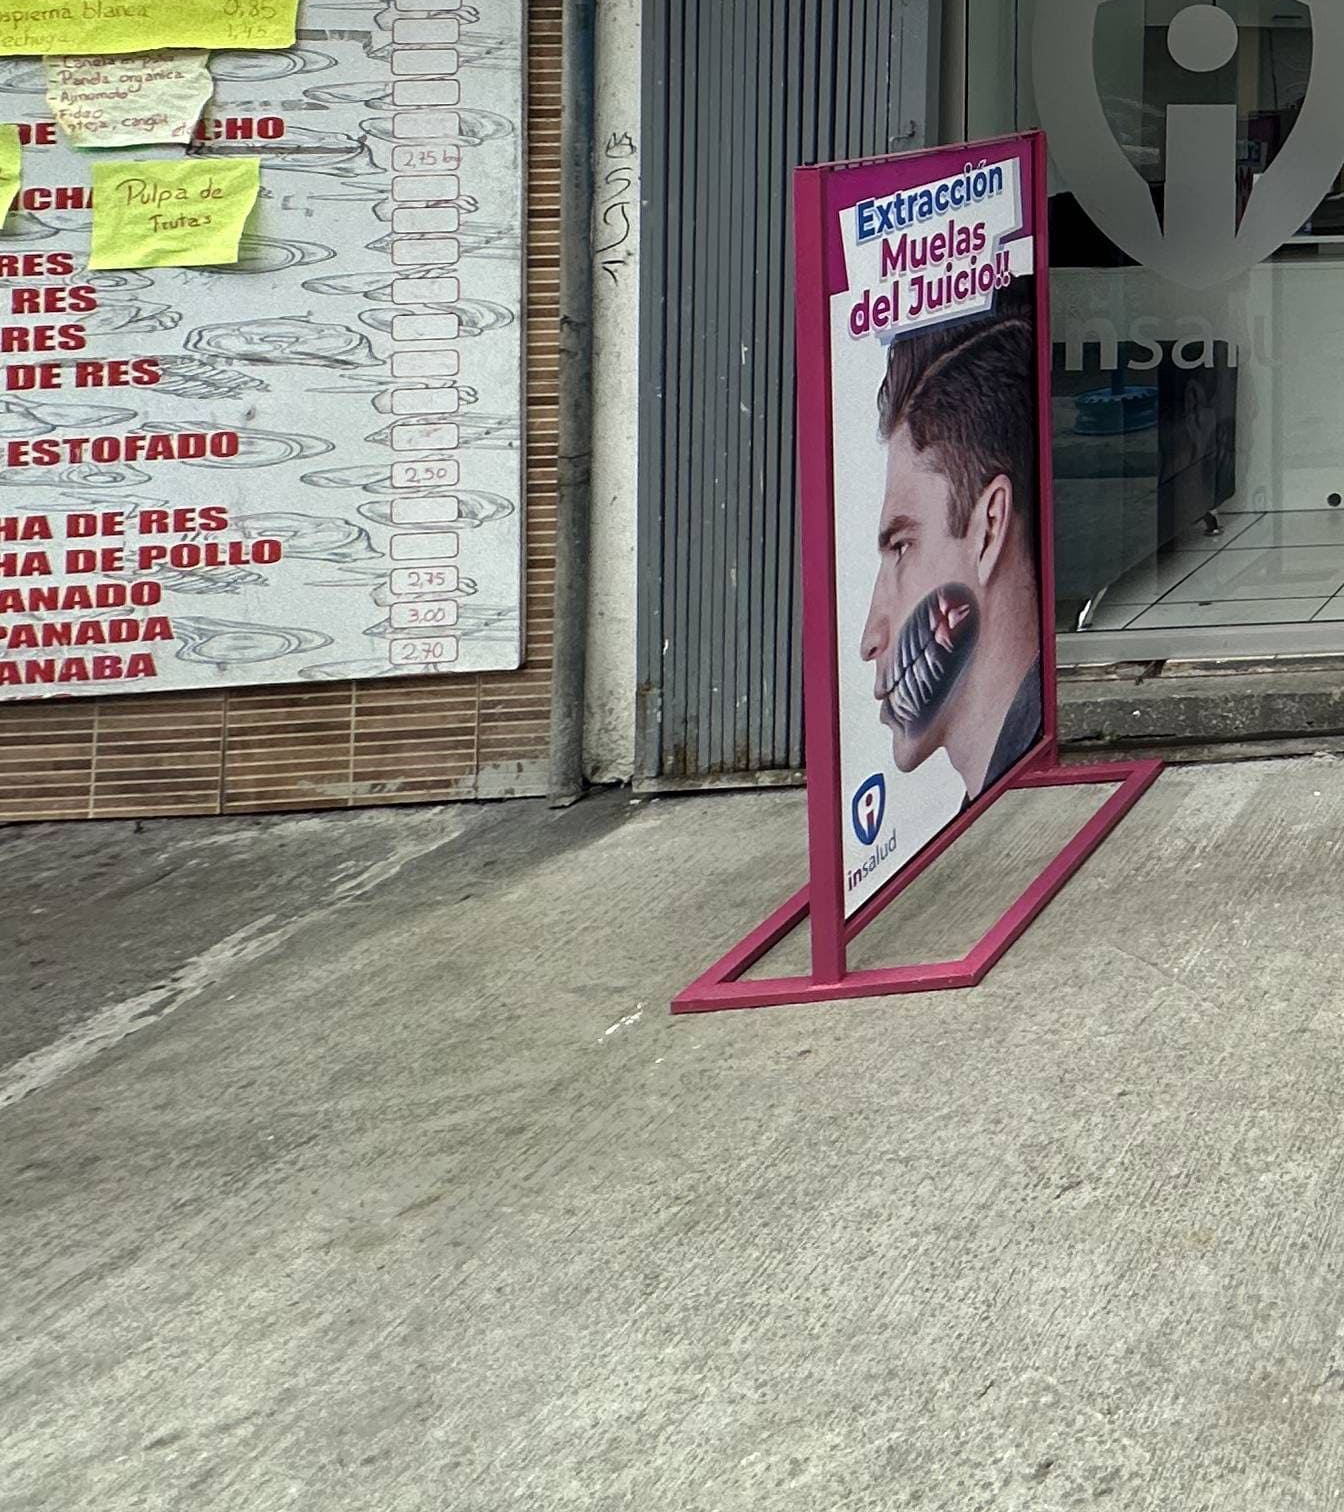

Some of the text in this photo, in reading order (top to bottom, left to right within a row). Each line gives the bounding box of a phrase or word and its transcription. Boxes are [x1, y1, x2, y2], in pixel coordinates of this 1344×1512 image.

[115, 177, 188, 208] Pulpa
[200, 177, 224, 200] de
[857, 160, 1003, 240] Extracción
[880, 219, 986, 279] Muelas
[11, 285, 98, 315] RES
[850, 249, 1011, 336] del Juicio!!
[1, 324, 87, 352] RES
[6, 358, 161, 391] DE RES
[7, 431, 240, 467] ESTOFADO
[66, 512, 125, 539] DE
[139, 506, 229, 535] RES
[66, 546, 124, 574] DE
[138, 539, 282, 570] POLLO
[0, 616, 175, 650] ANADA
[847, 828, 898, 892] insalud
